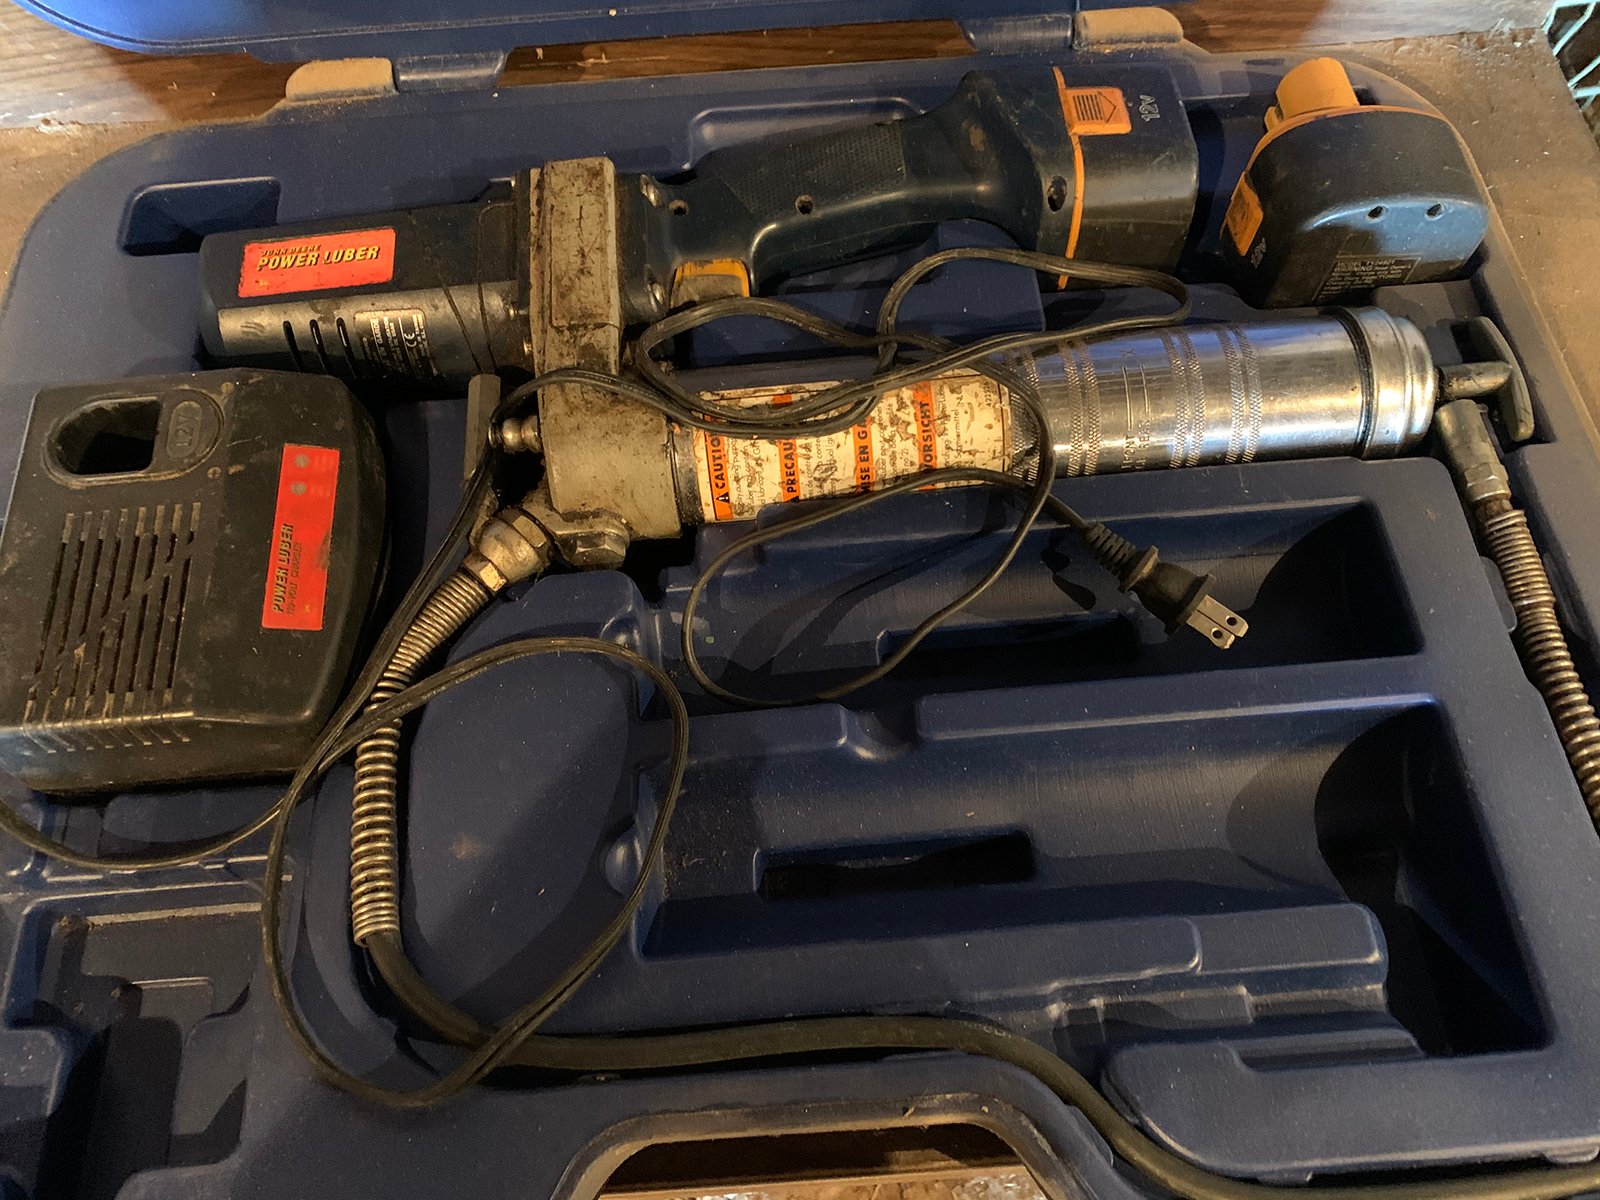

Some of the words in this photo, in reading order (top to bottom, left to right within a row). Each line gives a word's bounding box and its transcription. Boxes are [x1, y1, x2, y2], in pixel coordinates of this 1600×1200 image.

[257, 252, 320, 271] POWER
[322, 246, 381, 264] LUBER
[372, 319, 384, 345] GARDE
[859, 445, 870, 463] EN
[919, 401, 935, 469] VORSICHT
[710, 434, 726, 489] CAUTIO
[782, 442, 797, 494] PRECAU
[278, 523, 294, 565] LUBER
[272, 566, 289, 613] POWER
